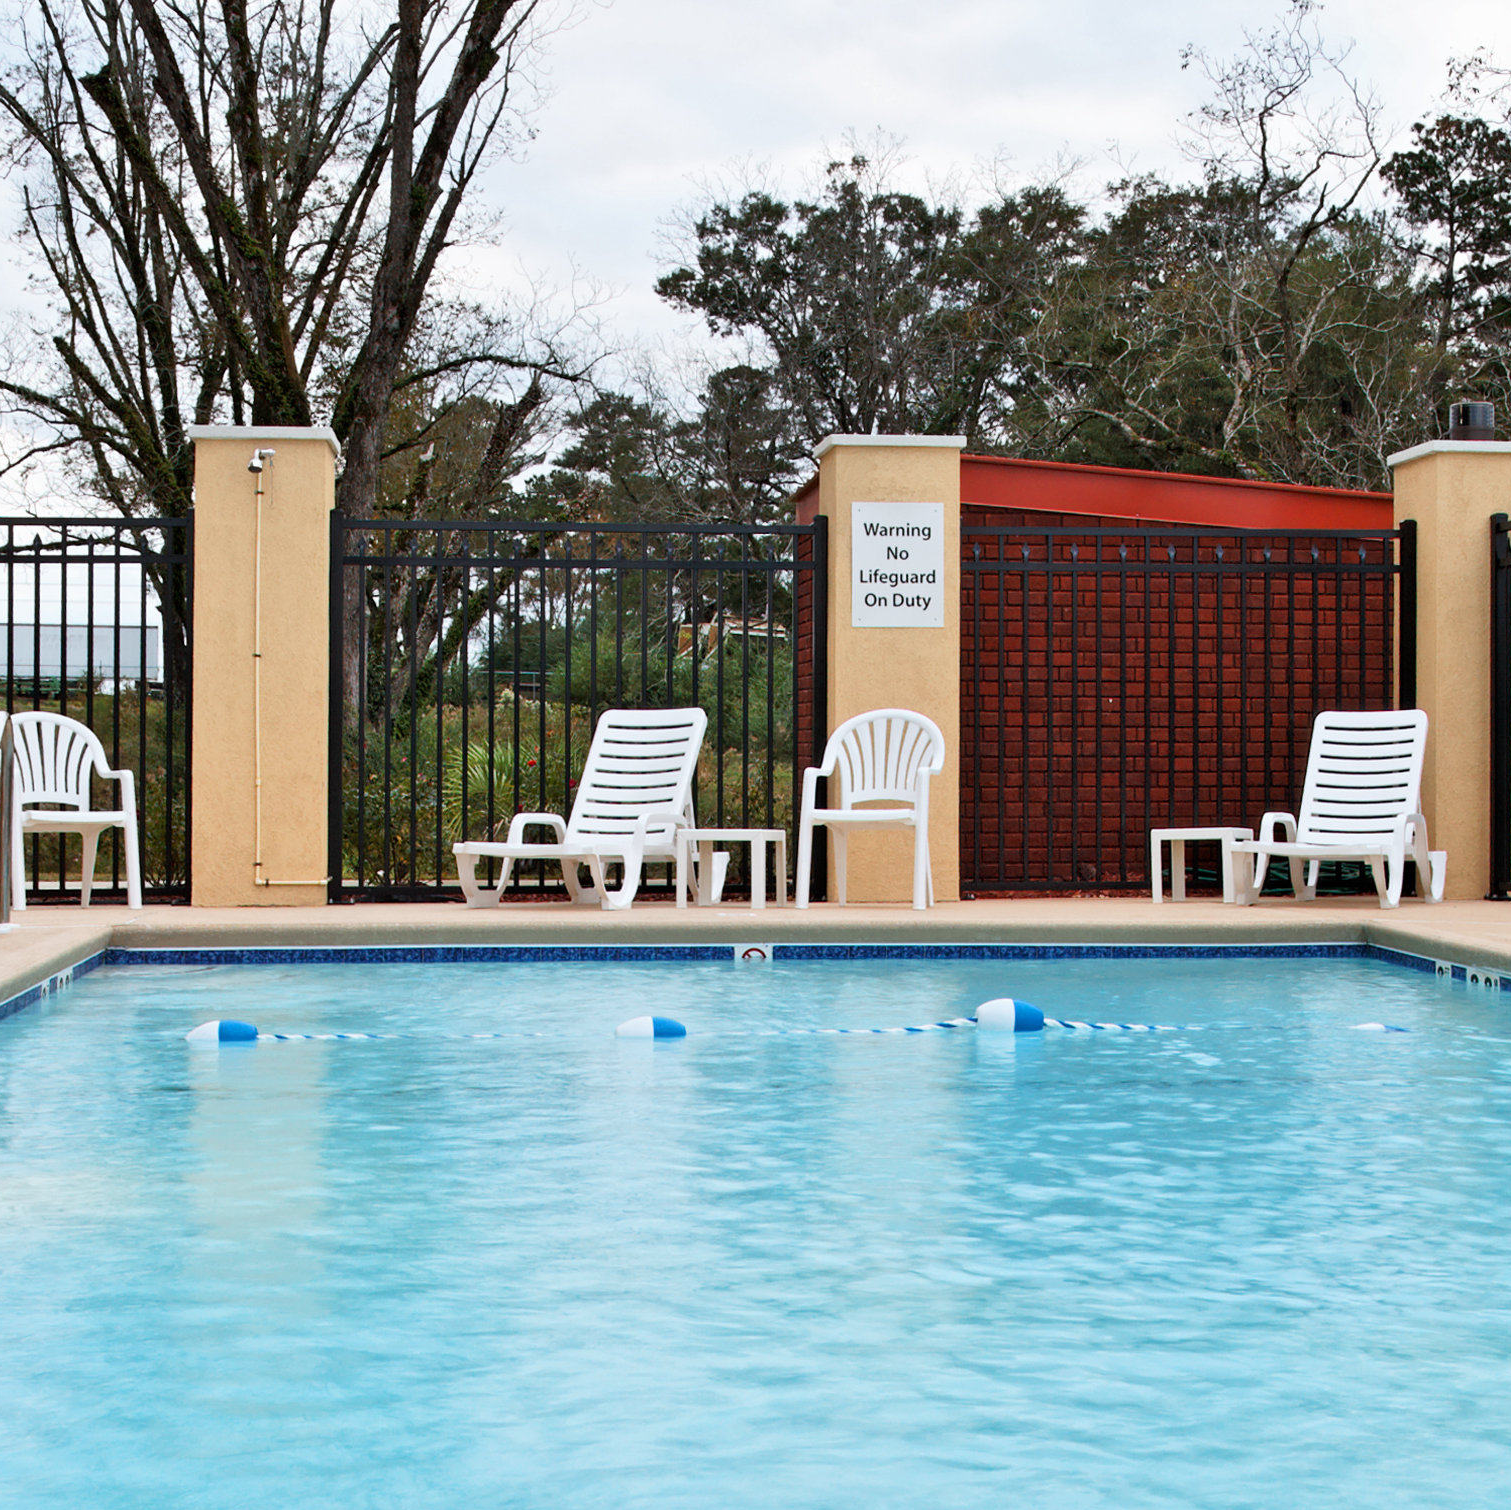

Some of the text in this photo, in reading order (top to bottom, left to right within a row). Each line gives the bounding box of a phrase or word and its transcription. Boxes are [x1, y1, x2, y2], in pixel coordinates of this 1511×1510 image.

[863, 522, 932, 541] Warning
[886, 546, 910, 561] No
[859, 569, 937, 587] Lifeguard
[864, 593, 932, 611] On Duty
